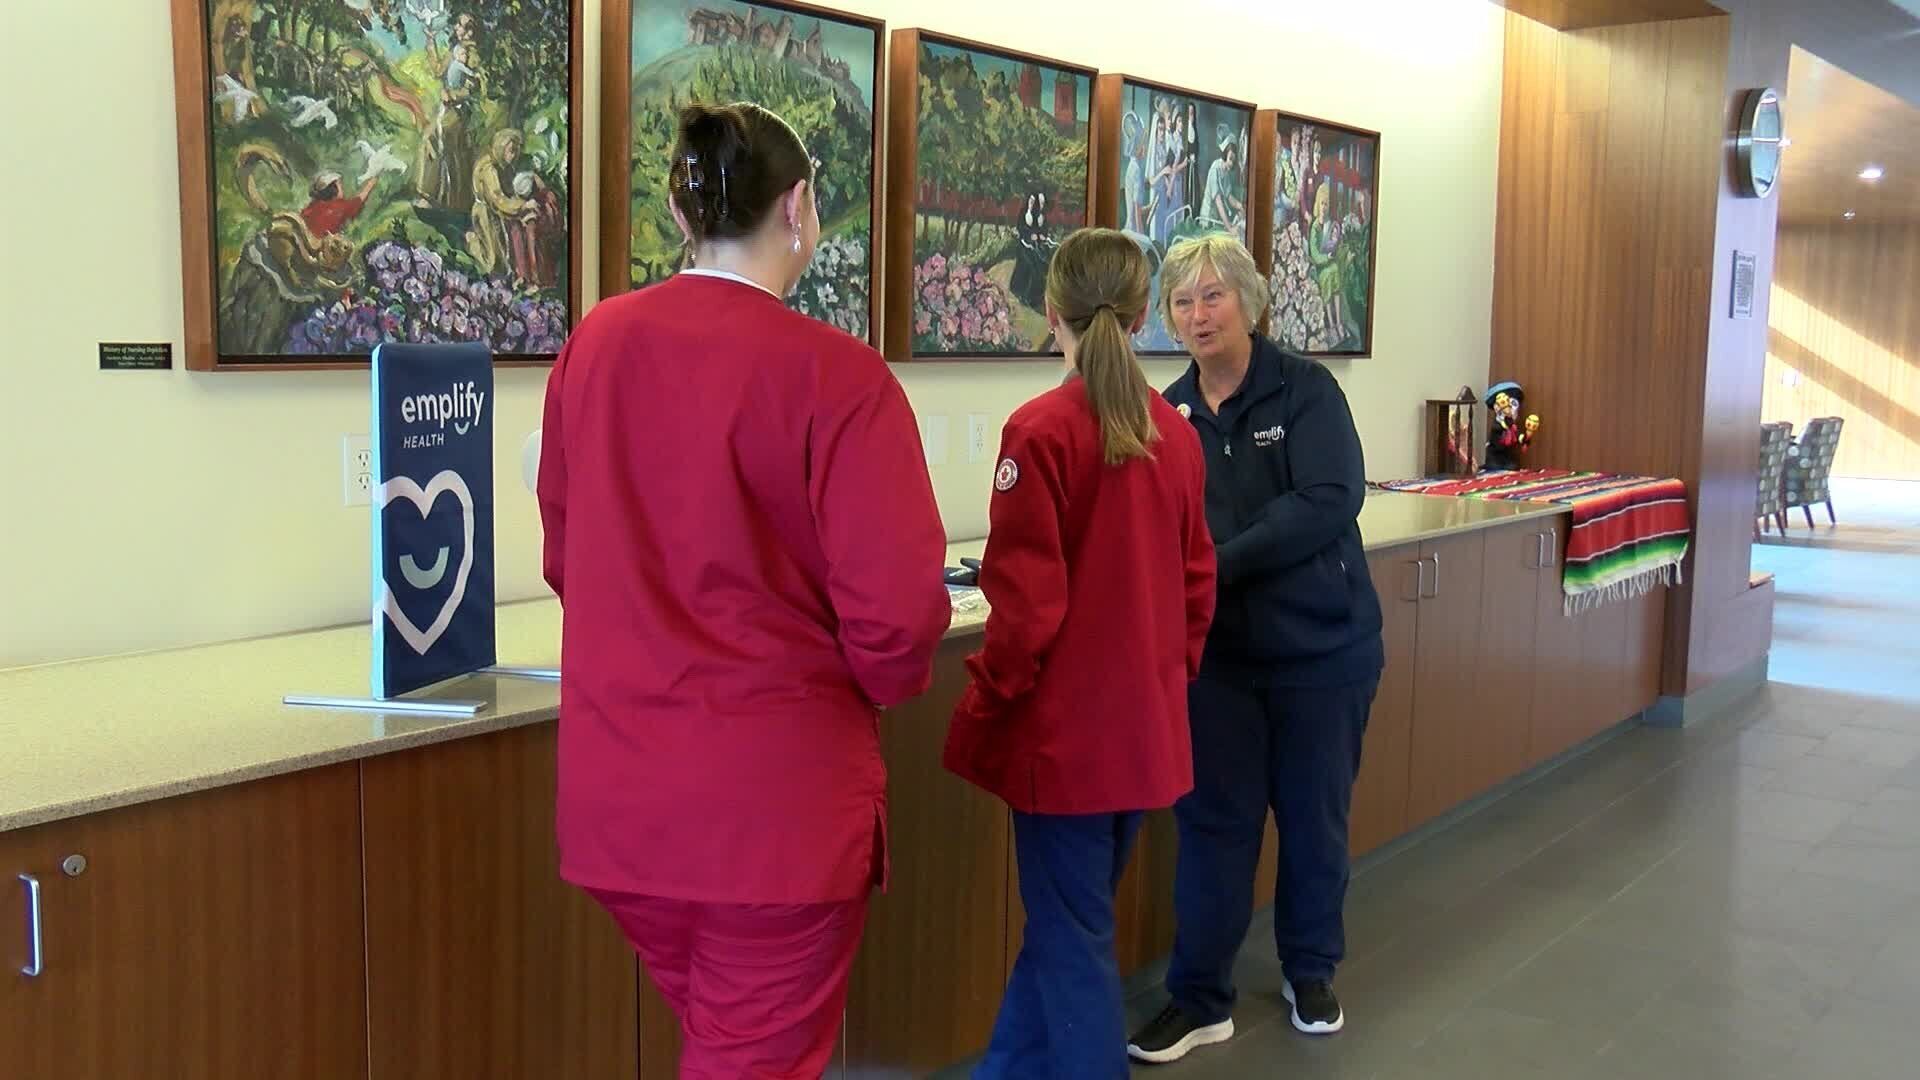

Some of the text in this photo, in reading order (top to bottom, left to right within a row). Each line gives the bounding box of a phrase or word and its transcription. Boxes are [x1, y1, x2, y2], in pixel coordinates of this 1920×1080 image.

[401, 381, 485, 430] emplify
[403, 433, 445, 449] HEALTH
[1253, 425, 1285, 441] emplify
